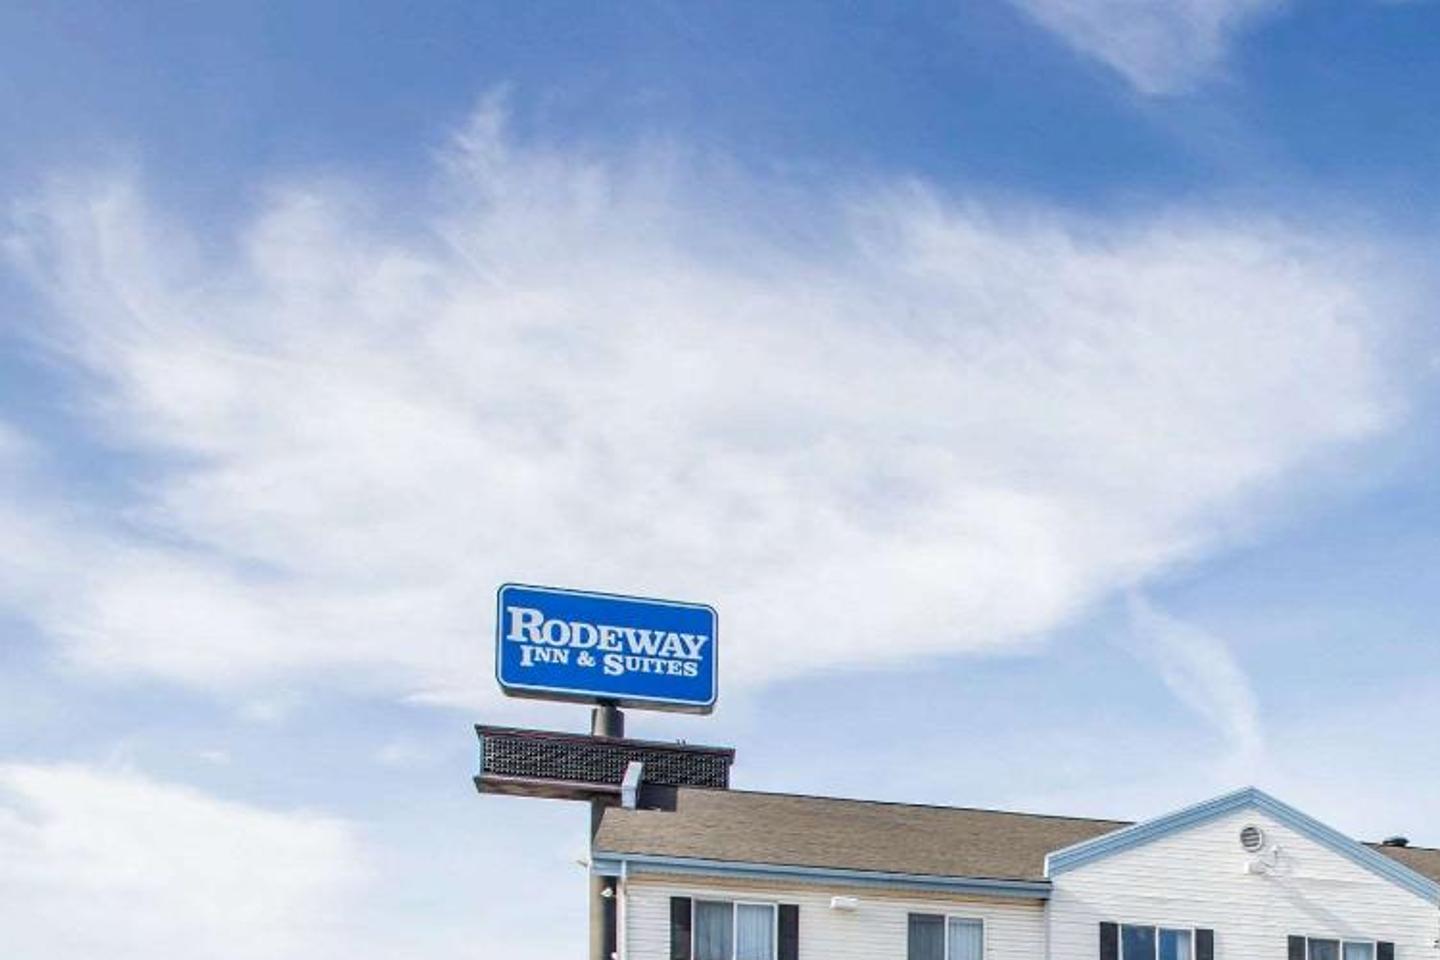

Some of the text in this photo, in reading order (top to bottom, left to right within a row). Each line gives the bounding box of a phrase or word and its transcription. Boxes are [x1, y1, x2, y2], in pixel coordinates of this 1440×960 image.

[506, 606, 709, 660] RODEWAY
[520, 645, 698, 677] INN & SUITES
